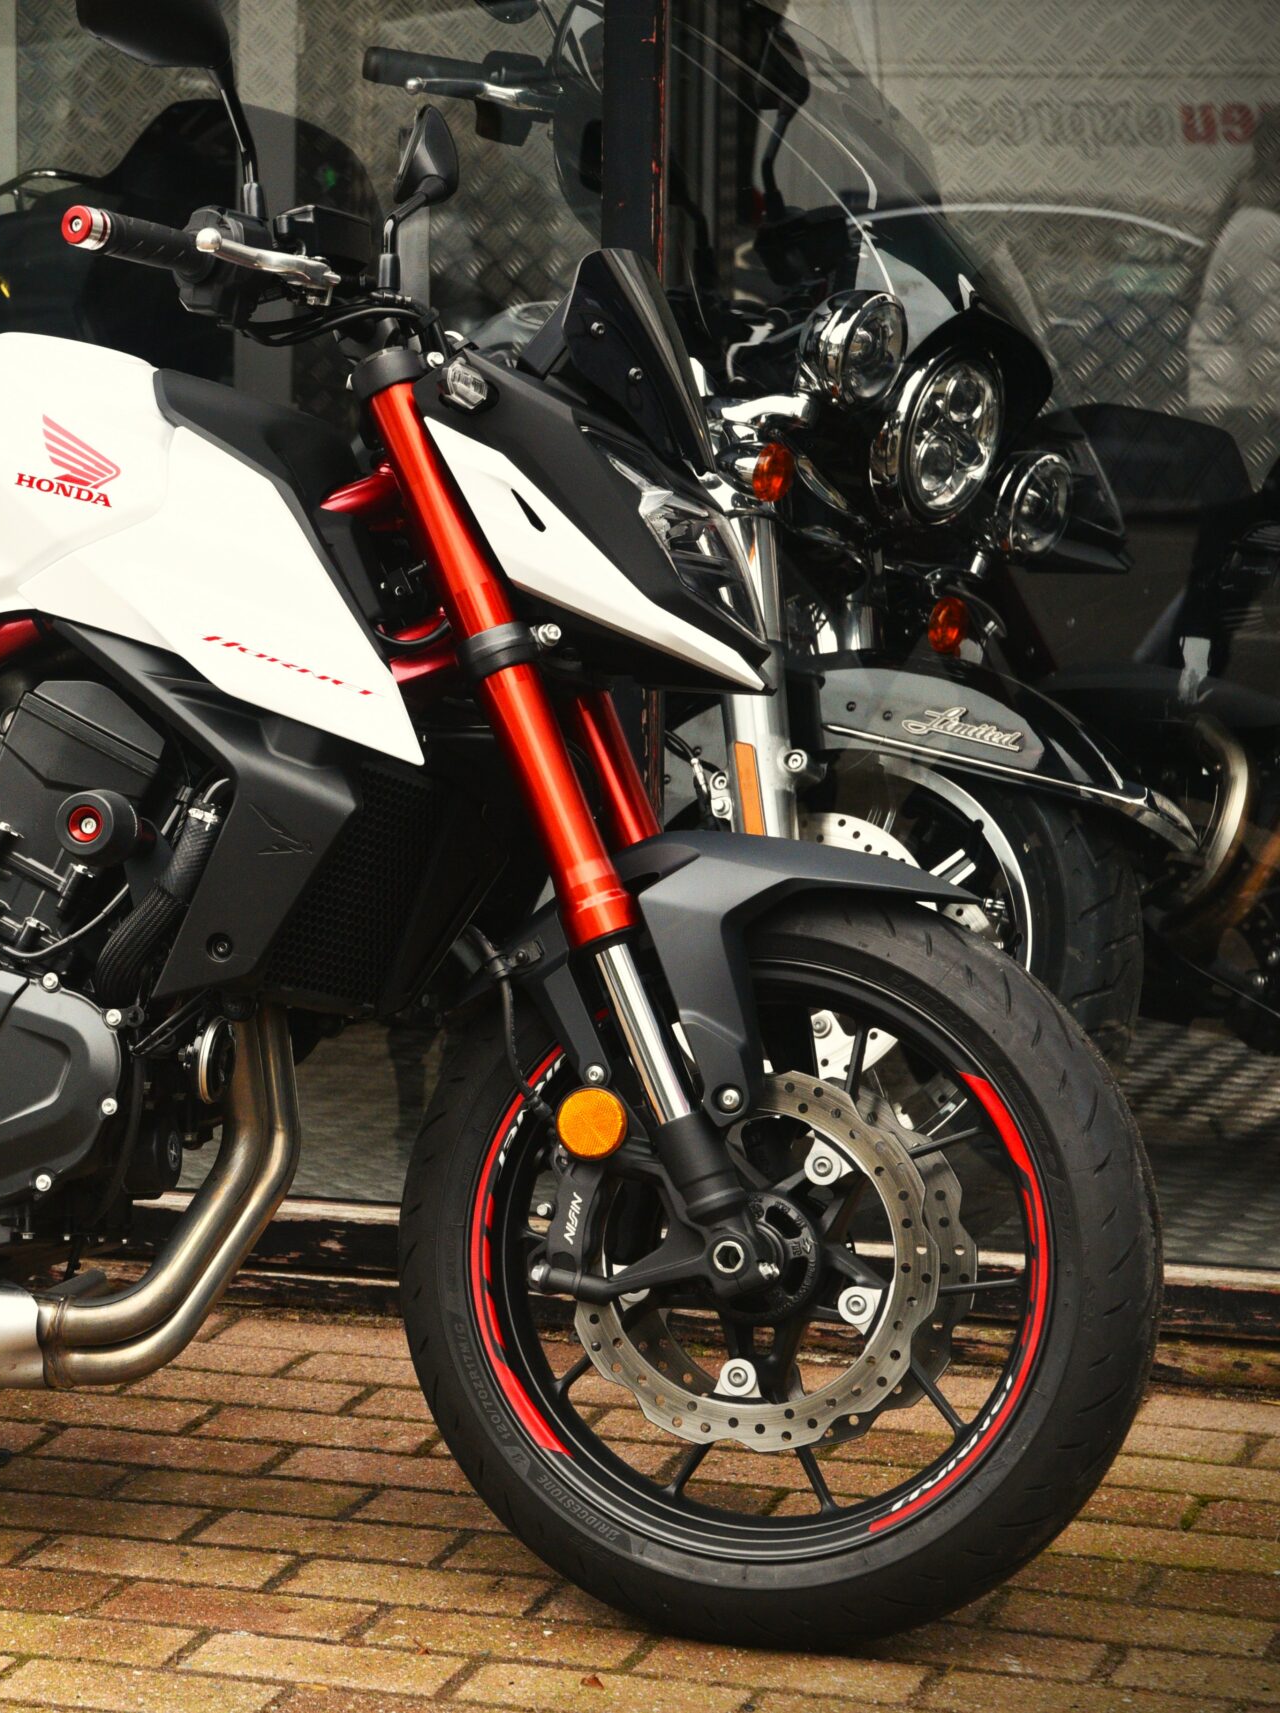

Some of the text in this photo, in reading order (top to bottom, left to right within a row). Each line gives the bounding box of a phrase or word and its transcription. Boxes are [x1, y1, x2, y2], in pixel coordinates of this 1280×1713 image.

[14, 472, 113, 508] HONDA
[901, 706, 1023, 752] Limited
[536, 1473, 623, 1542] BRIDGESTONE
